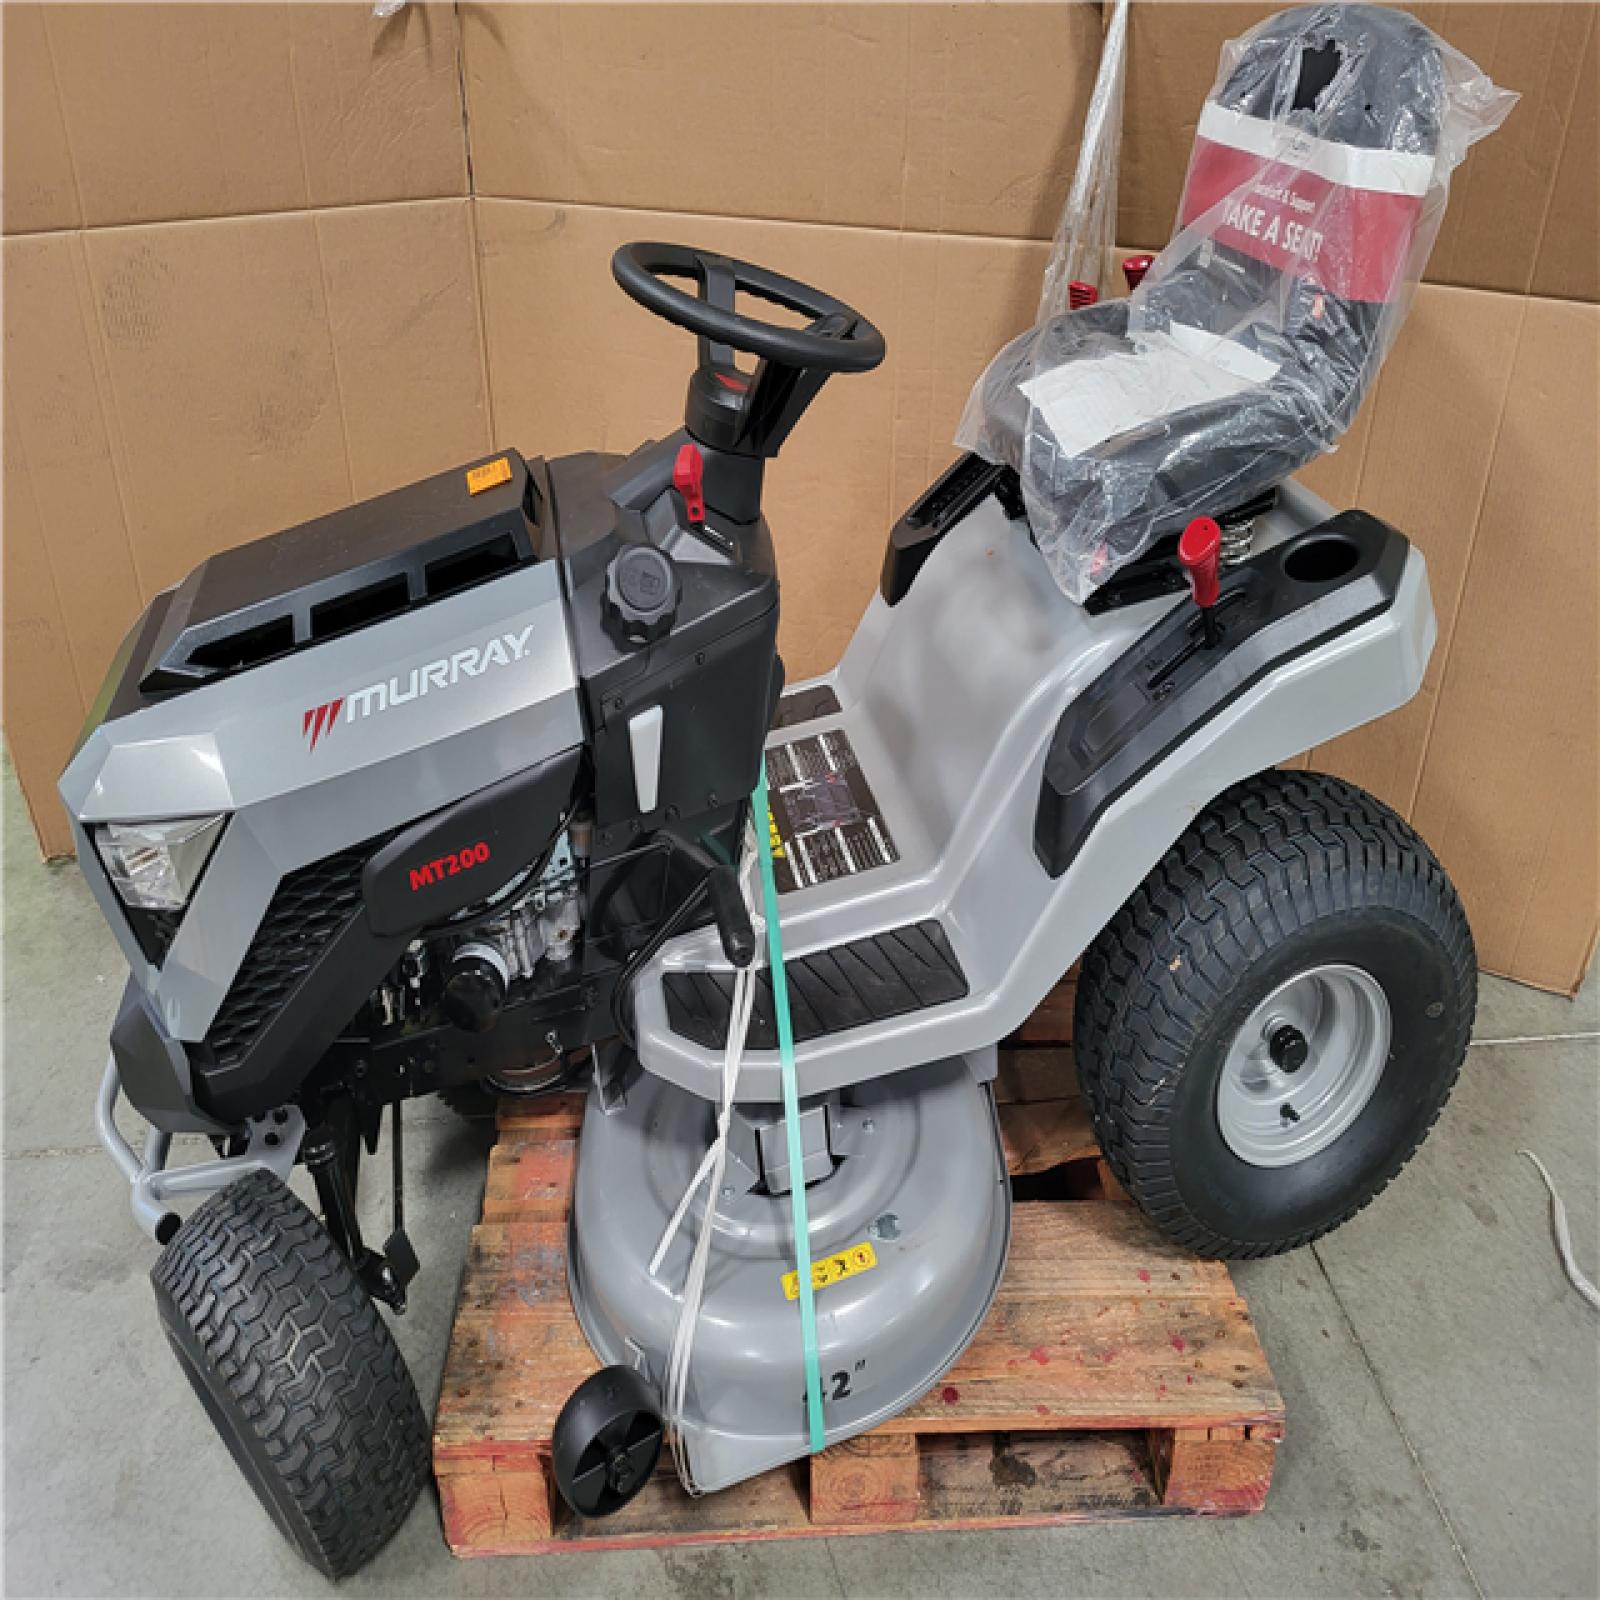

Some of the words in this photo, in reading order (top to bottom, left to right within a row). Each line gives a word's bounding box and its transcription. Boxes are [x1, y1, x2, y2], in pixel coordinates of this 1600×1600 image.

[1262, 215, 1281, 246] A
[345, 624, 534, 724] MURRAY
[409, 842, 490, 891] MT200
[803, 1359, 867, 1403] 2"
